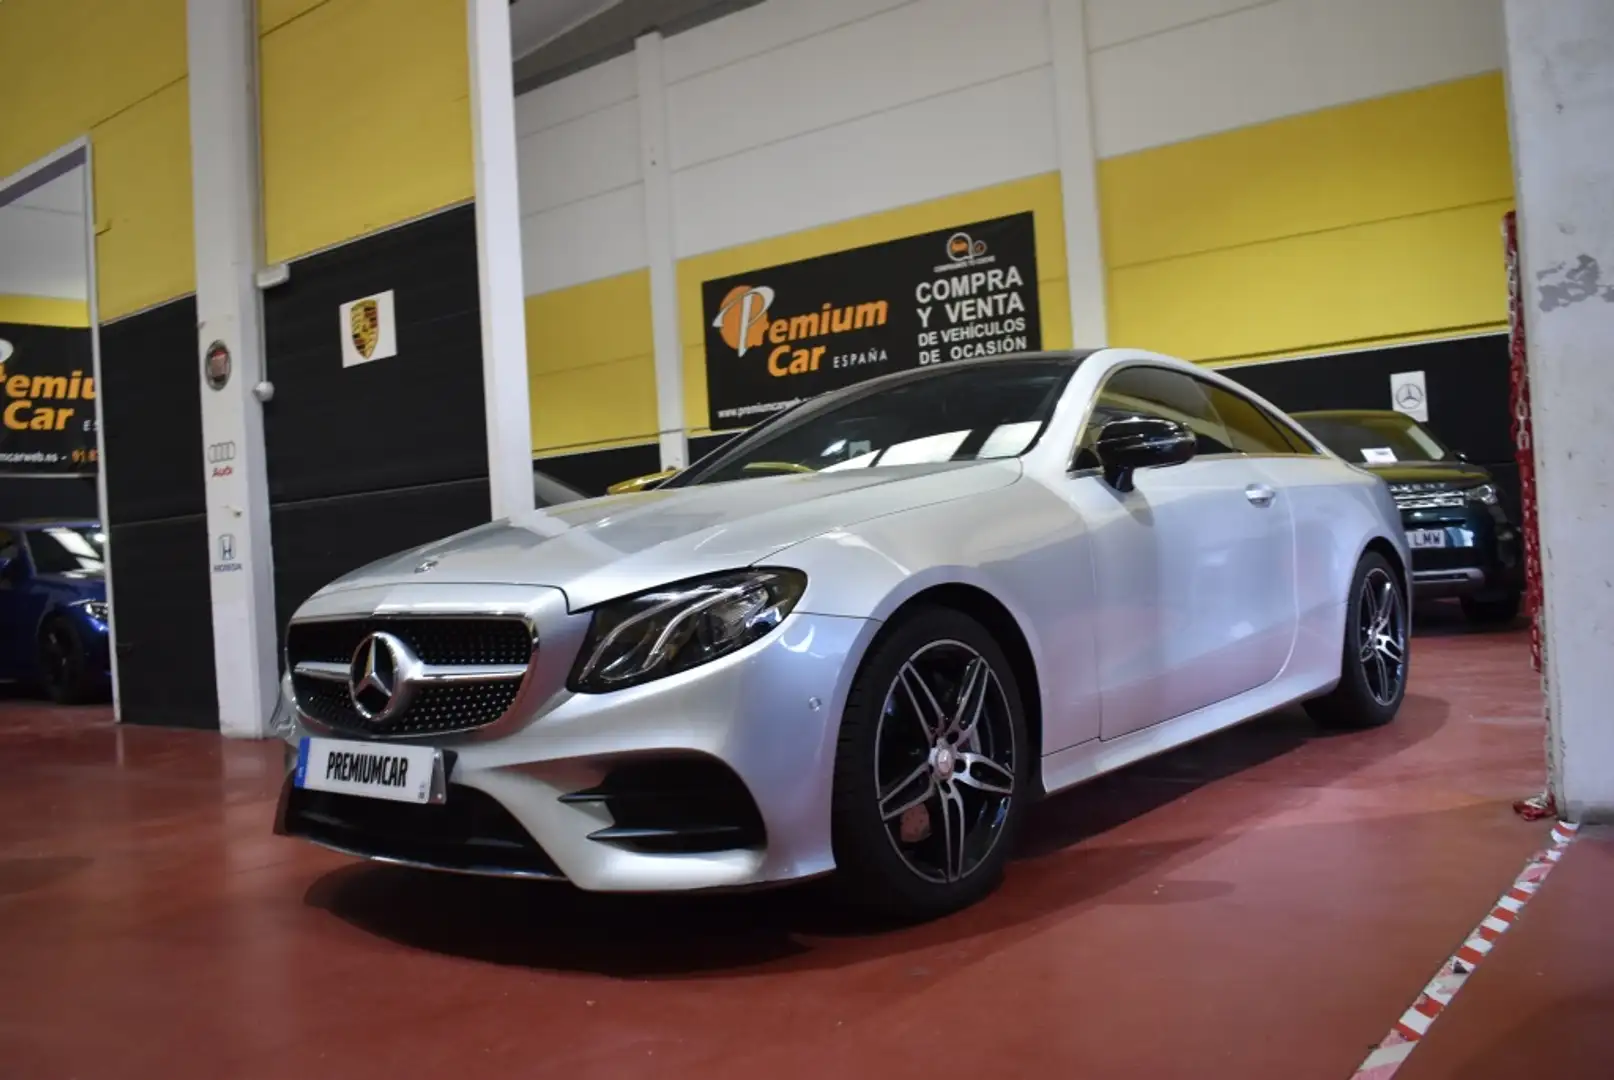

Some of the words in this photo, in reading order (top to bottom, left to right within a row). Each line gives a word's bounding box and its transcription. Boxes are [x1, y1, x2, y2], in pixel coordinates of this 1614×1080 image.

[915, 265, 1024, 304] COMPRA
[916, 305, 933, 329] Y
[944, 291, 1025, 324] VENTA
[918, 331, 938, 347] DE
[940, 317, 1026, 343] VEHÍCULOS
[768, 343, 827, 377] Car
[833, 347, 888, 369] ESPAÑA
[919, 348, 941, 365] DE
[950, 335, 1027, 360] OCASIÓN
[3, 399, 75, 430] Car
[326, 751, 409, 788] PREMIUMCAR
